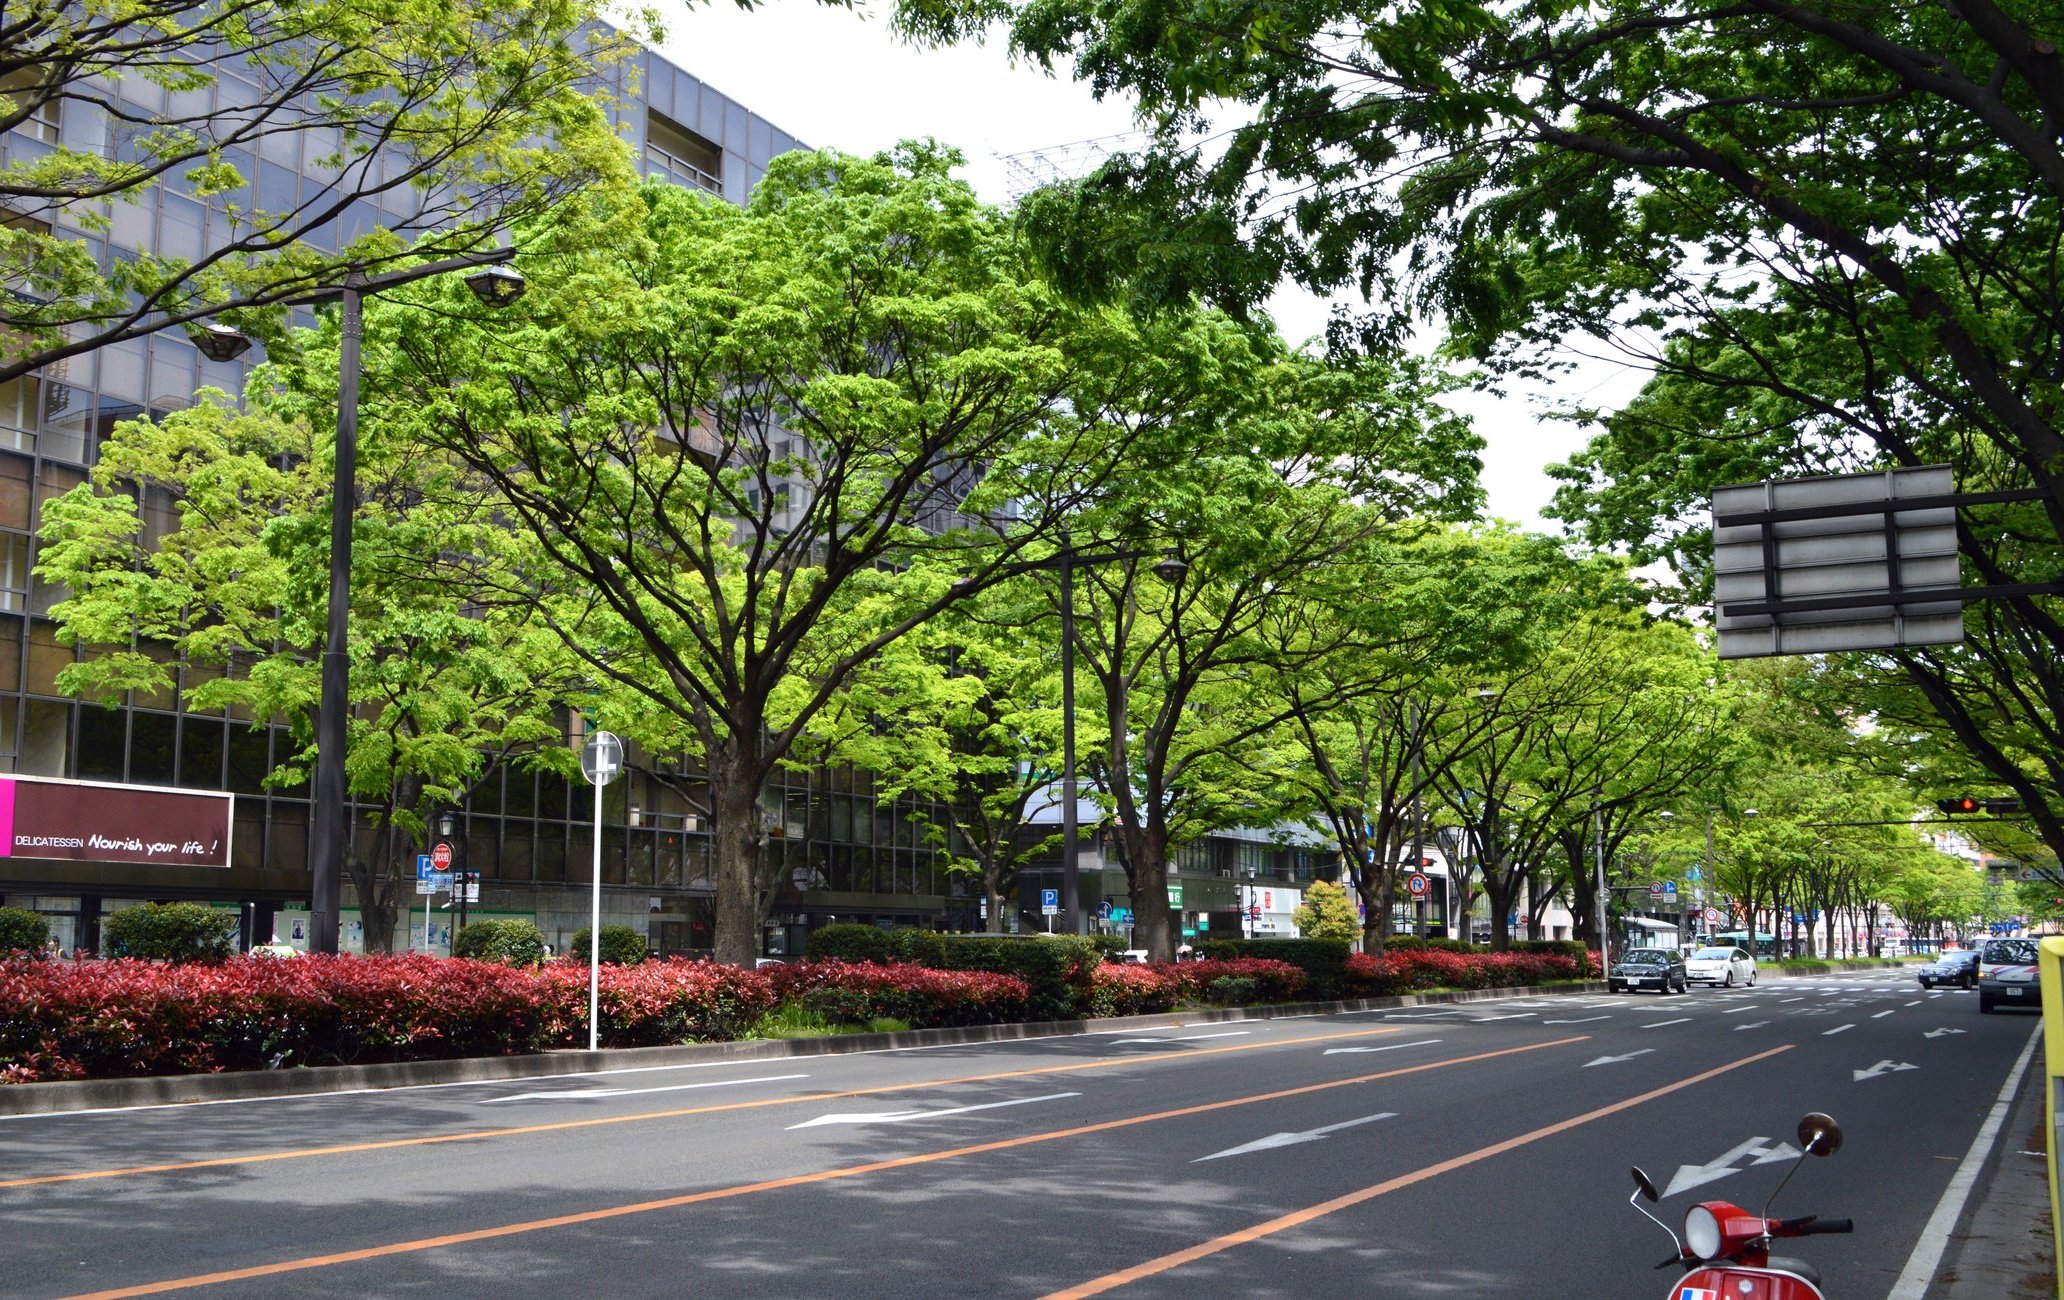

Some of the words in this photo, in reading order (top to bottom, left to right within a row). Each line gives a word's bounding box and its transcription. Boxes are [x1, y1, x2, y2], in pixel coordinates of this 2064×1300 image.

[15, 835, 84, 848] DELICATESSEN
[88, 834, 143, 851] Nourish
[146, 842, 178, 856] your
[181, 841, 205, 854] life
[1045, 891, 1054, 905] P
